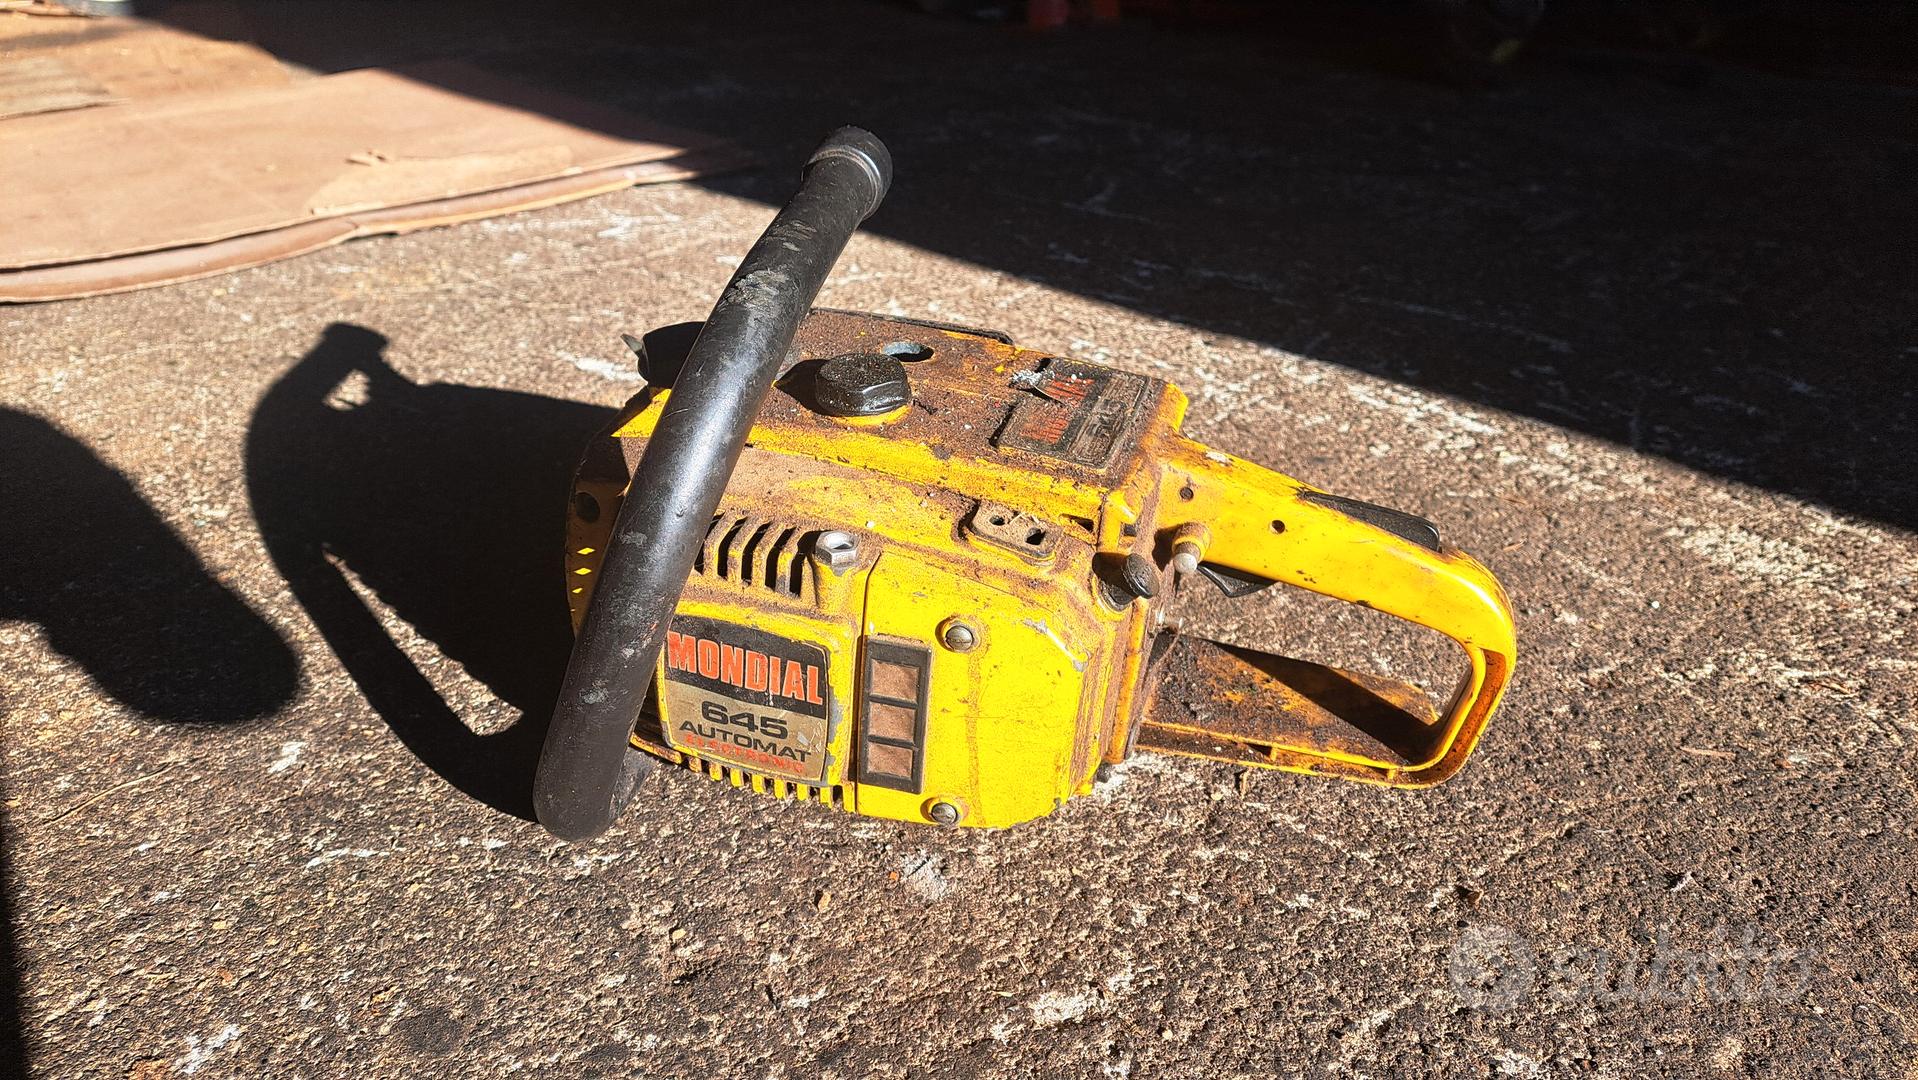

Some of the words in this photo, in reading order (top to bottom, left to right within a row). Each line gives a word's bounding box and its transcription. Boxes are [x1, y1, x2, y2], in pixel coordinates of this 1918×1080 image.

[668, 631, 823, 705] MONDIAL
[679, 720, 811, 763] AUTOMAT
[701, 700, 788, 740] 645
